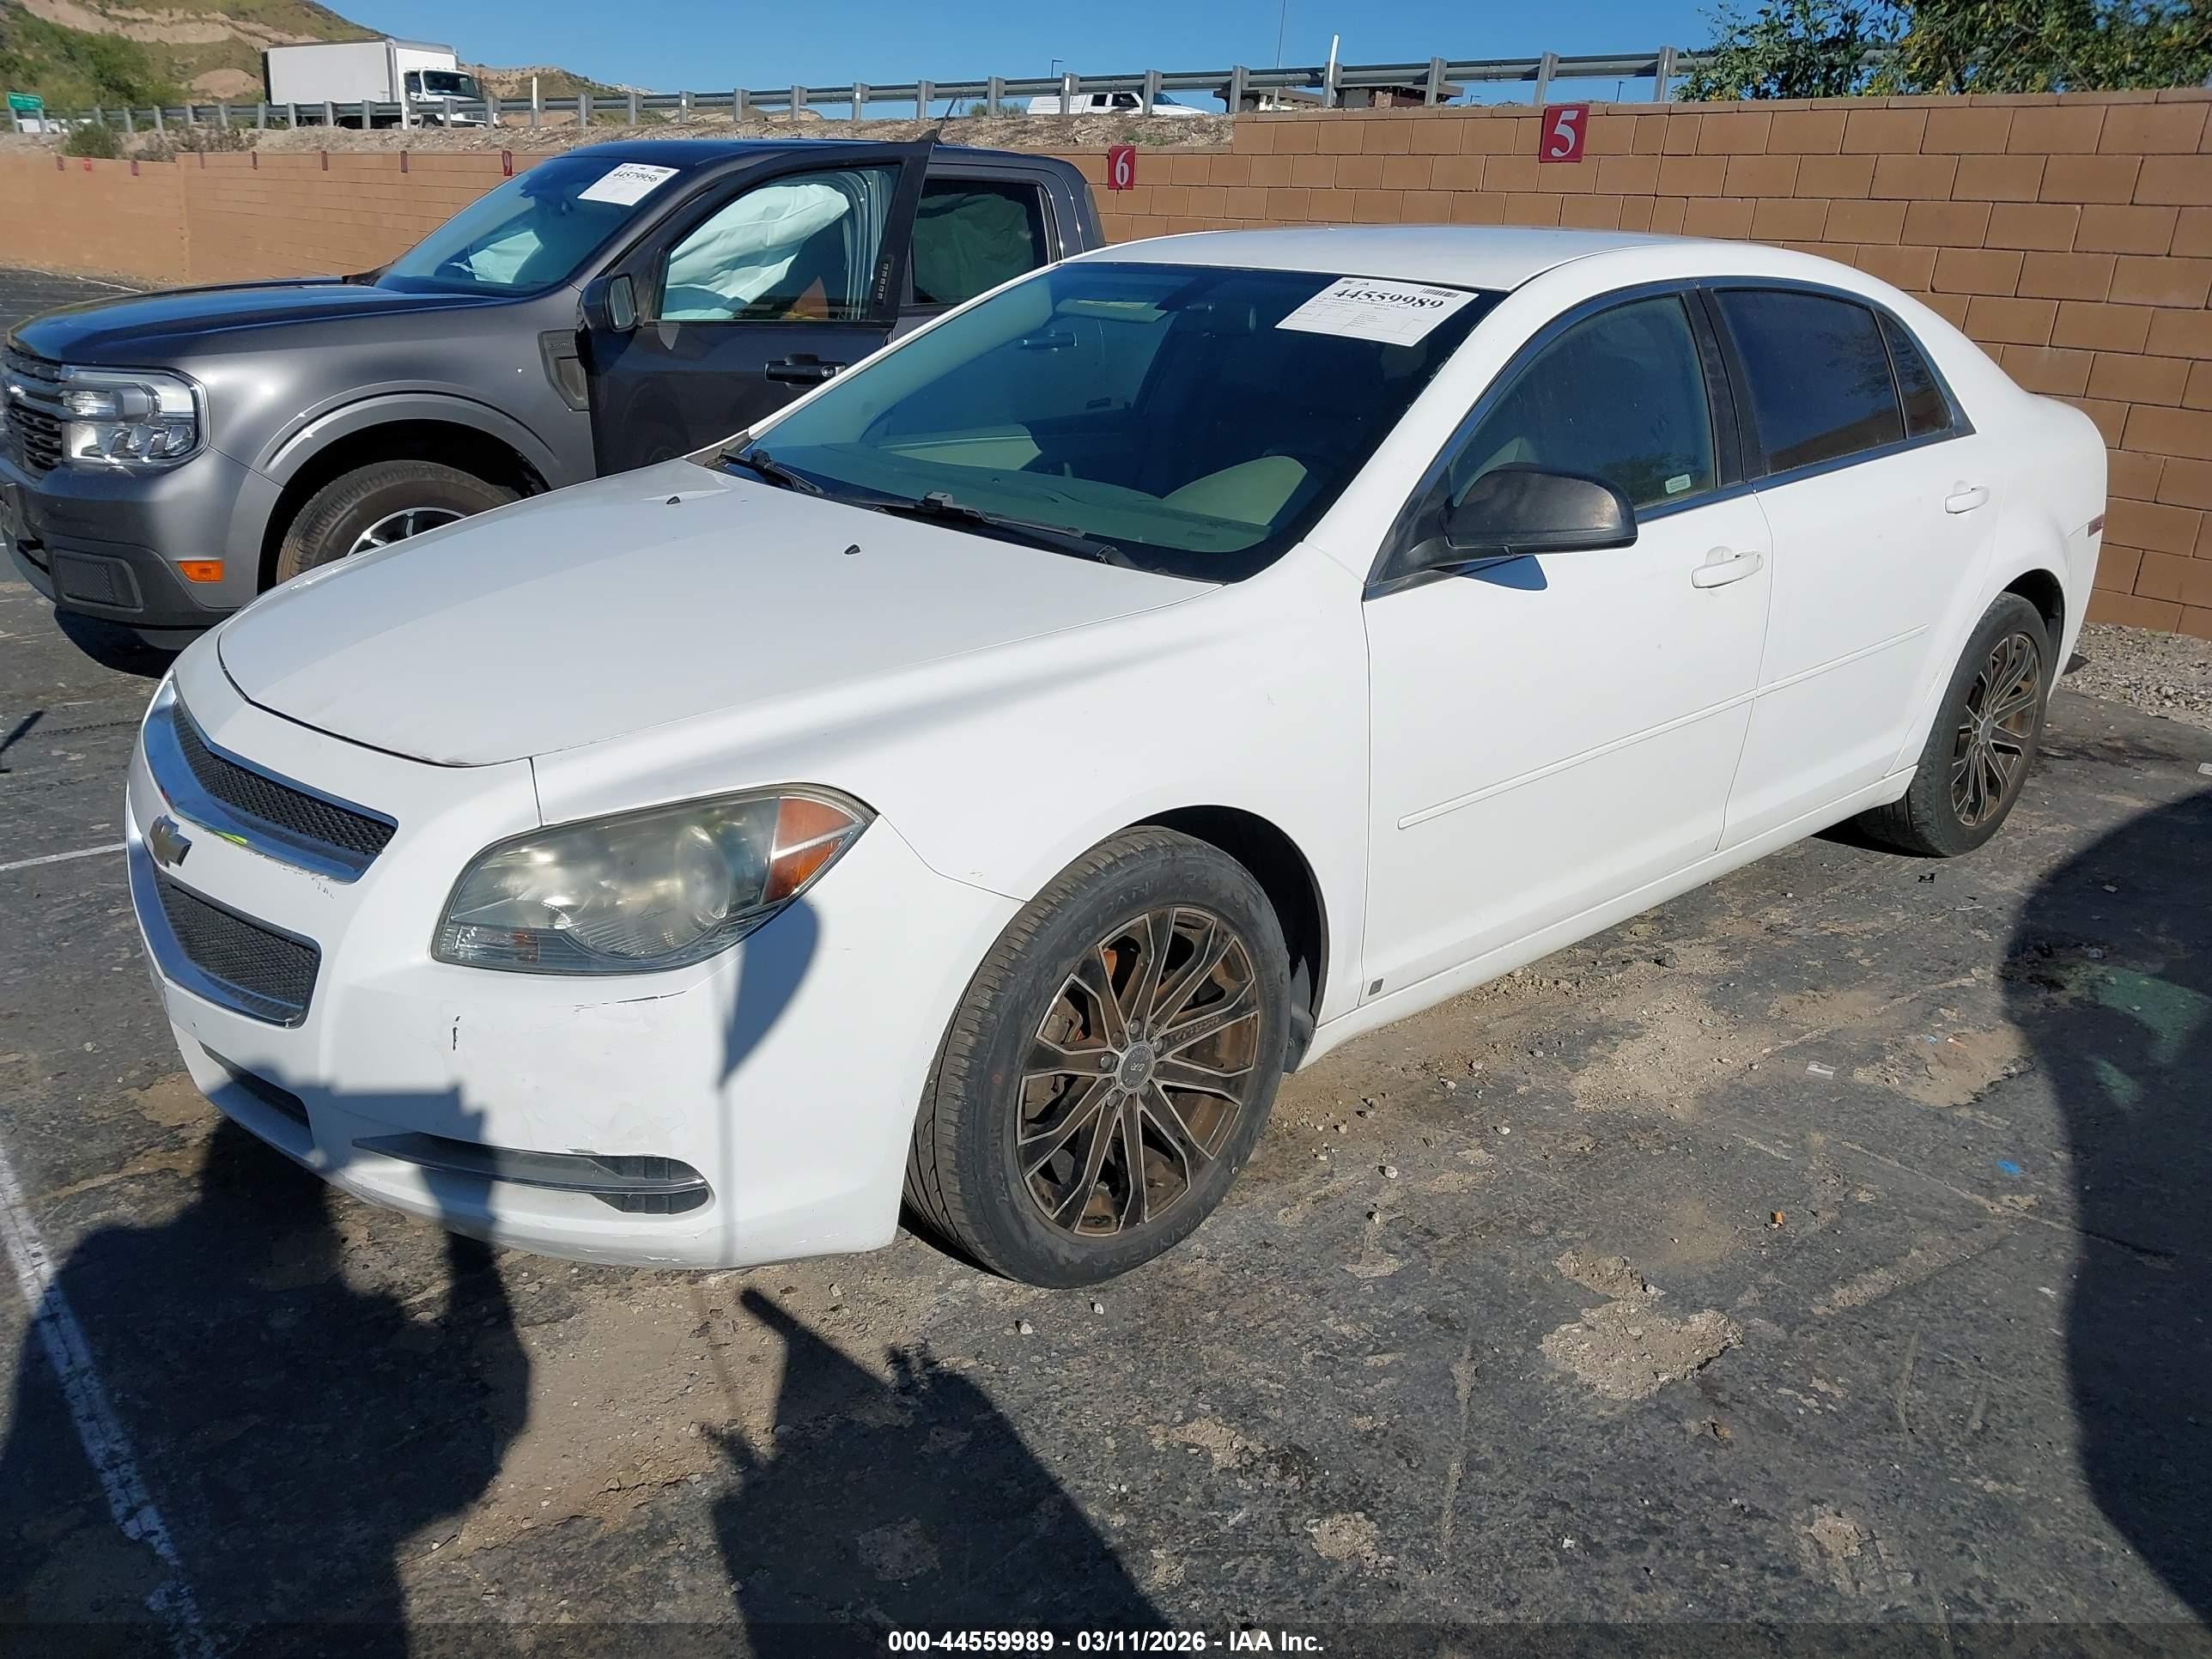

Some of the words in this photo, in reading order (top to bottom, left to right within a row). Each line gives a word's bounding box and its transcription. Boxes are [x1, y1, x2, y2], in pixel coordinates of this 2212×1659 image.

[1551, 110, 1579, 157] 5
[1115, 149, 1130, 185] 6
[1333, 288, 1444, 309] 44559989
